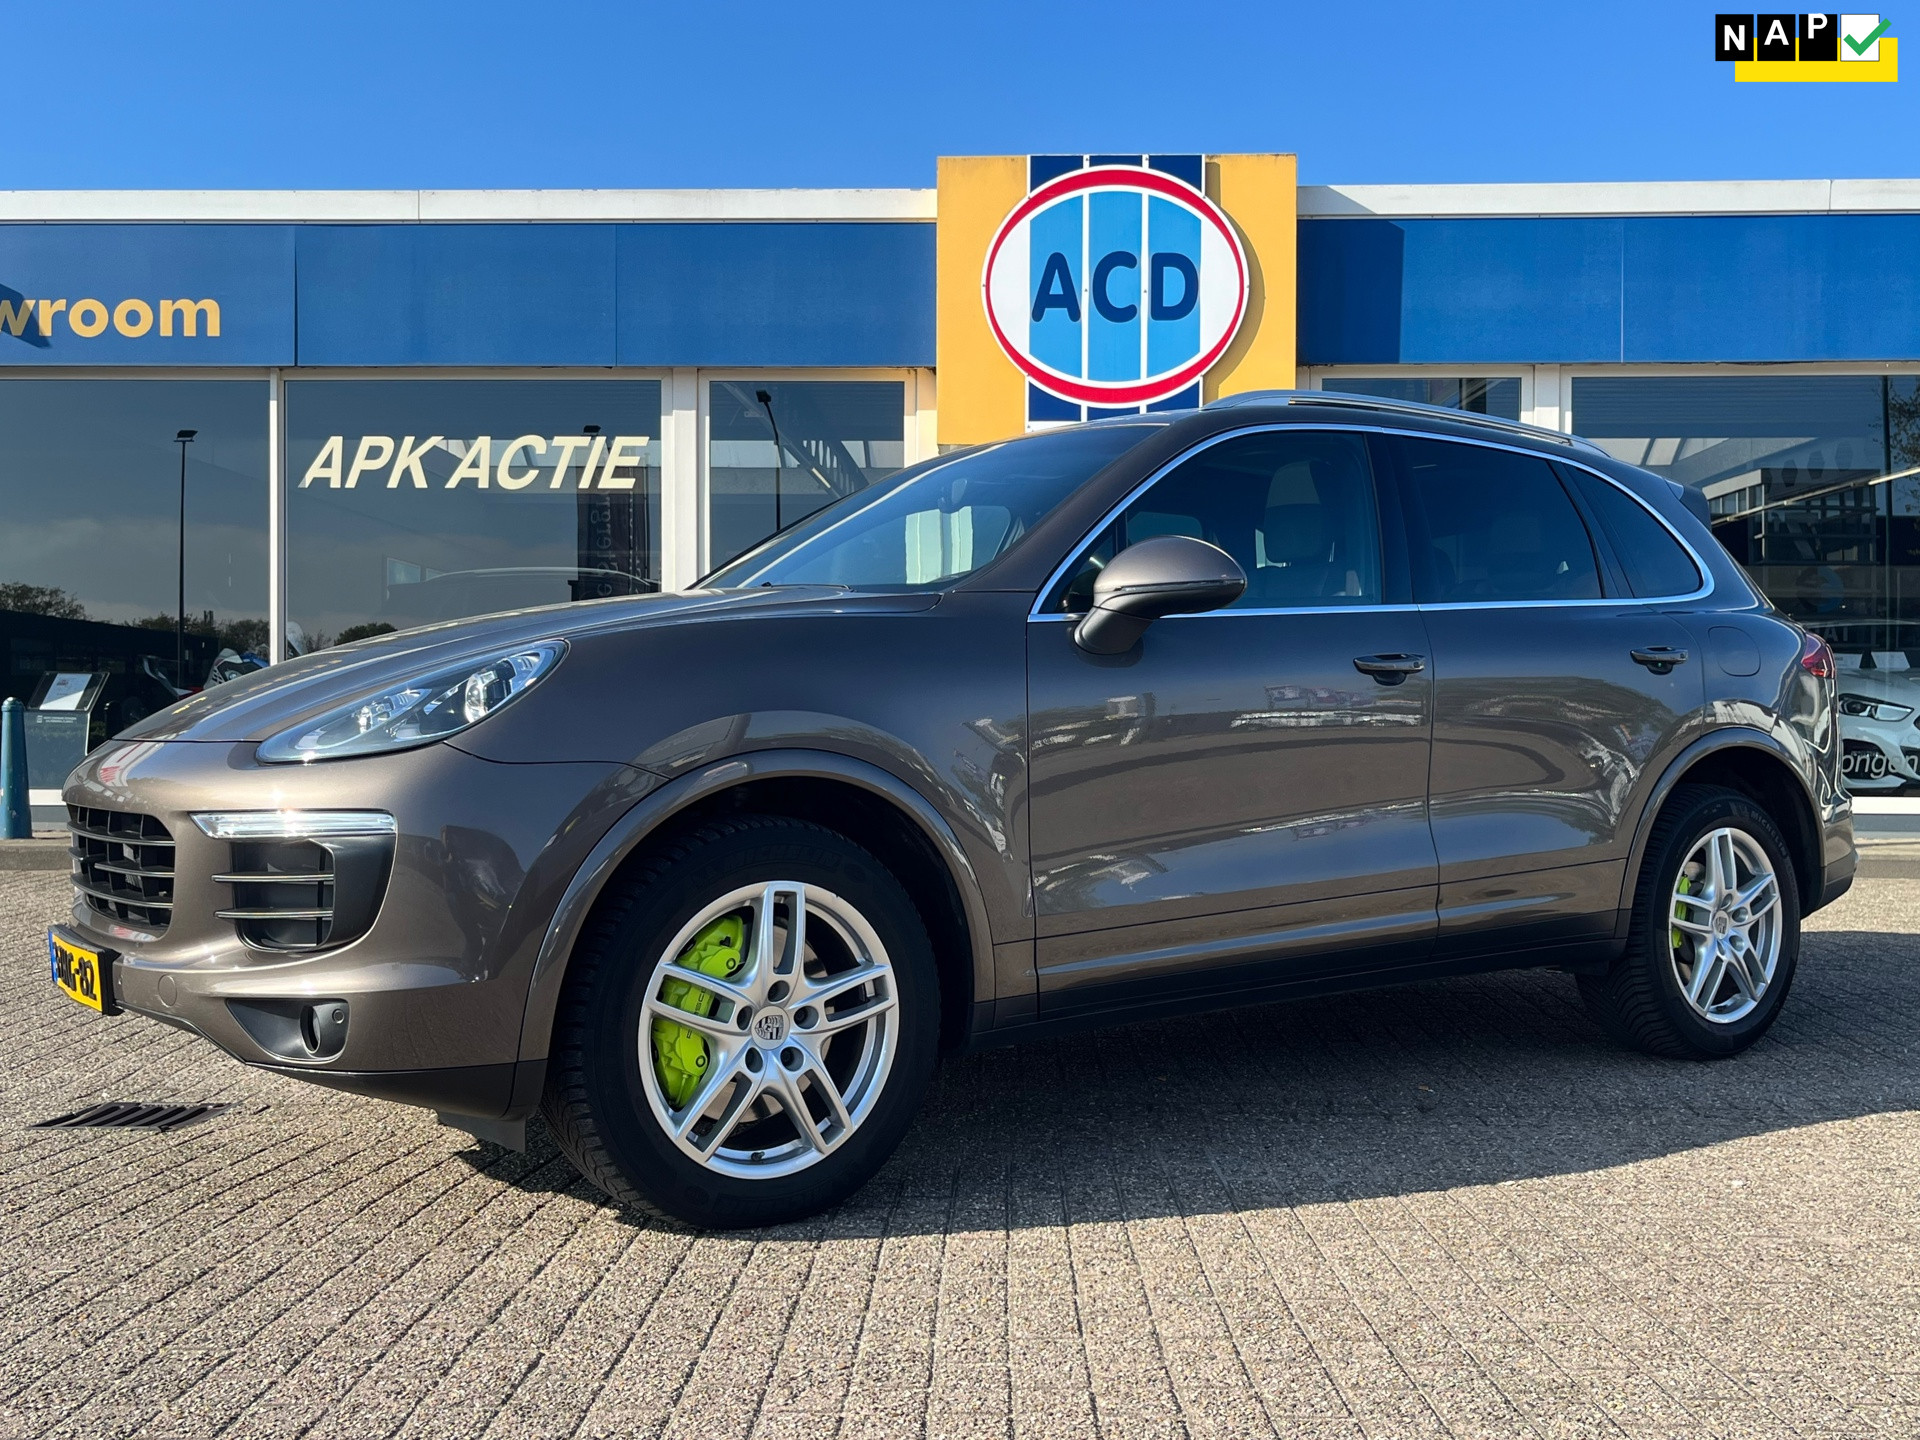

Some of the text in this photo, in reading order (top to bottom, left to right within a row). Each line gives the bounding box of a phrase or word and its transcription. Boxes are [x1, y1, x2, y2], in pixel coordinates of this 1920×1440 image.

[1031, 250, 1199, 323] ACD
[0, 298, 220, 338] wroom
[298, 434, 650, 489] APK ACTIE
